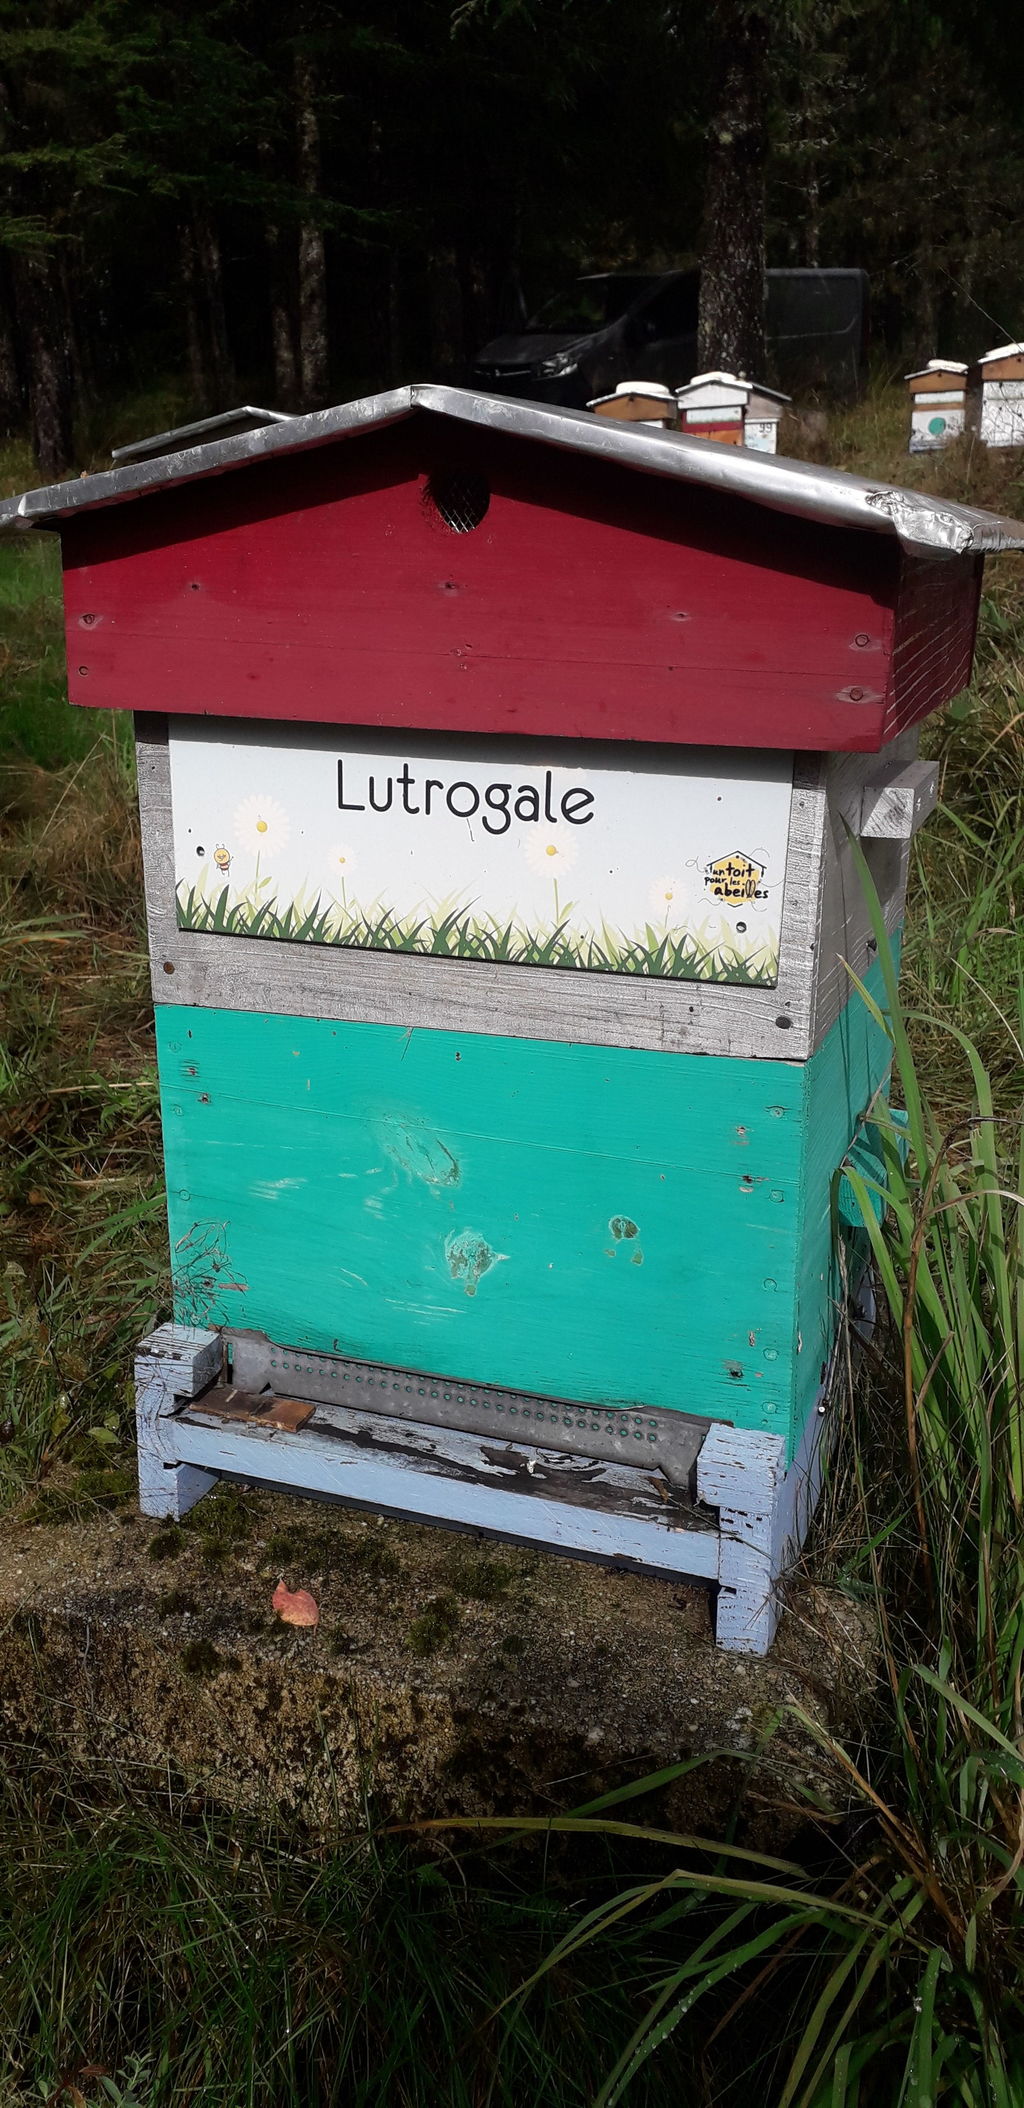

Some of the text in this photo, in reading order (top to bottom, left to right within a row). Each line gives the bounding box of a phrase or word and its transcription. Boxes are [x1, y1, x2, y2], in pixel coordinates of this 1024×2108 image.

[338, 760, 595, 834] Lutrogale
[726, 862, 756, 878] toit
[704, 877, 741, 886] pour les
[714, 880, 769, 899] abeilles
